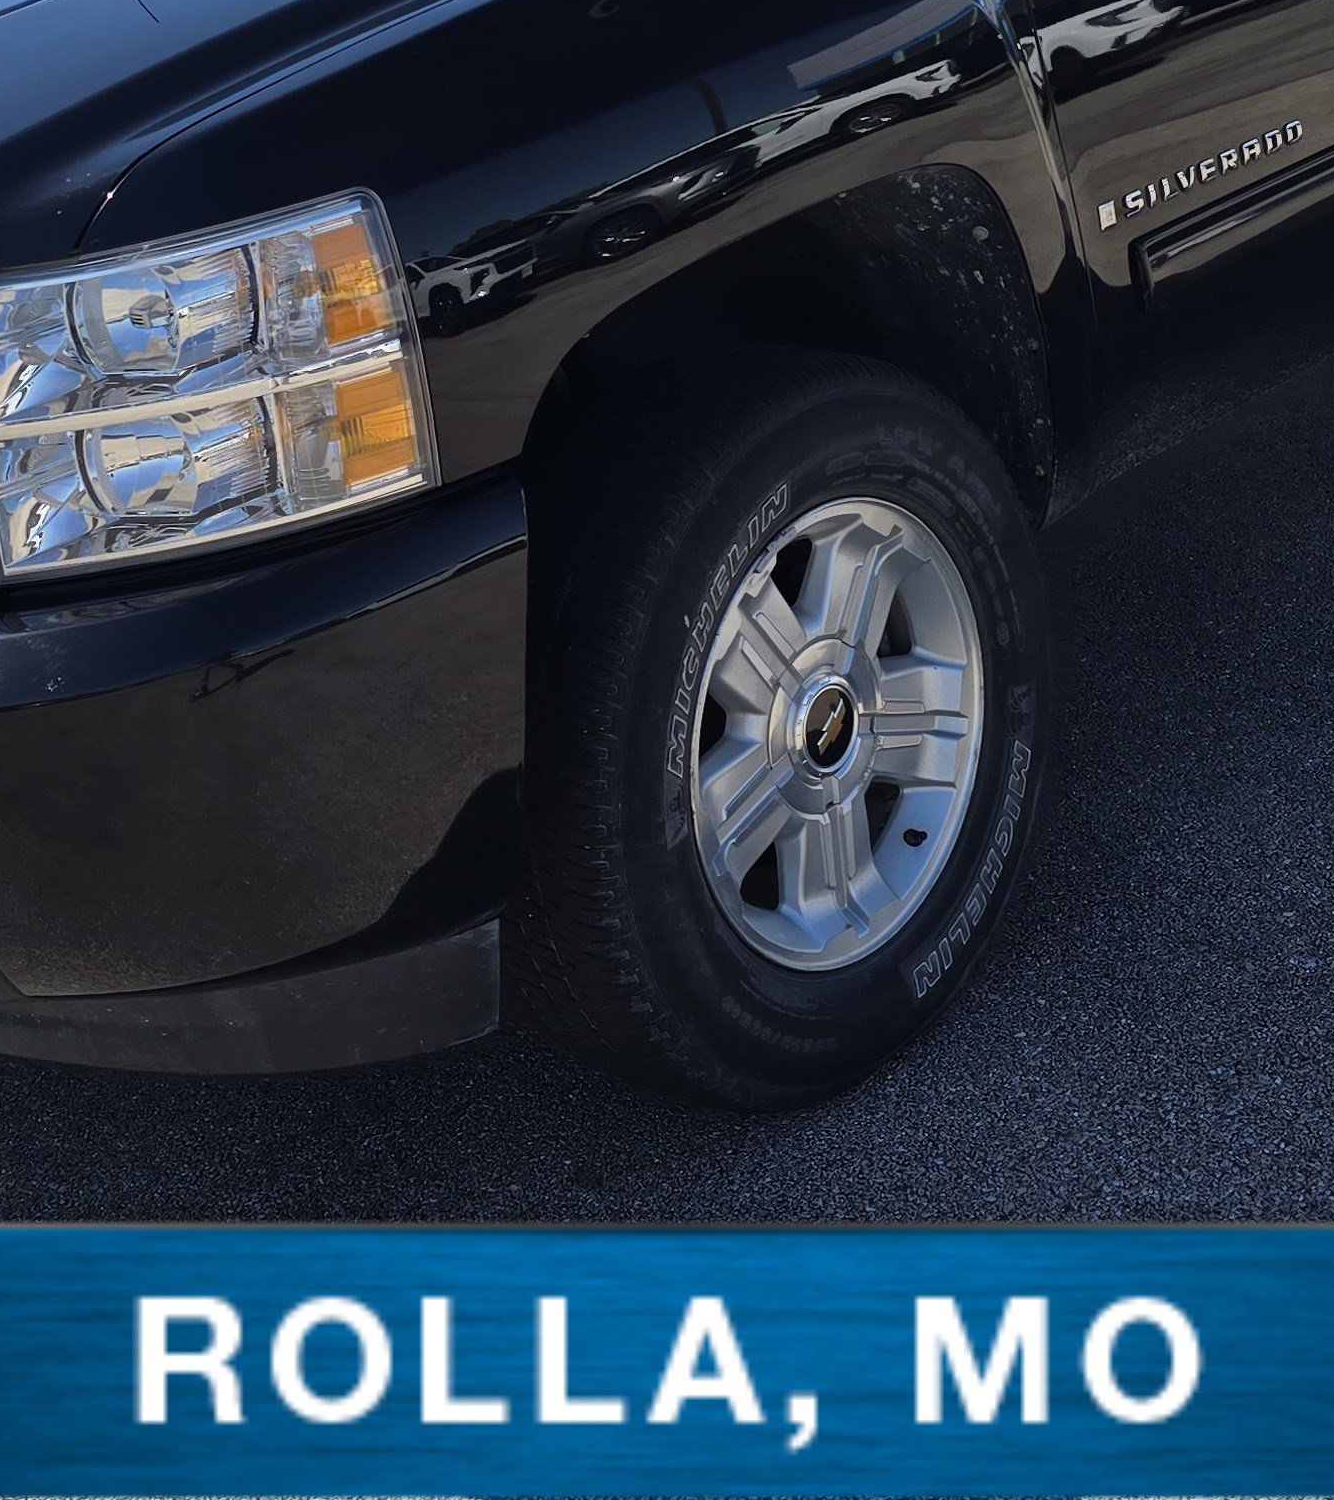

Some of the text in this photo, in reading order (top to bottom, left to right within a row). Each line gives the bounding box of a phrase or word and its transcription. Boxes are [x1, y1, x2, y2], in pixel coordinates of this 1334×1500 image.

[1122, 119, 1304, 219] SILVERADO
[668, 484, 793, 780] MICHELIN
[912, 741, 1032, 1000] MICHELIN
